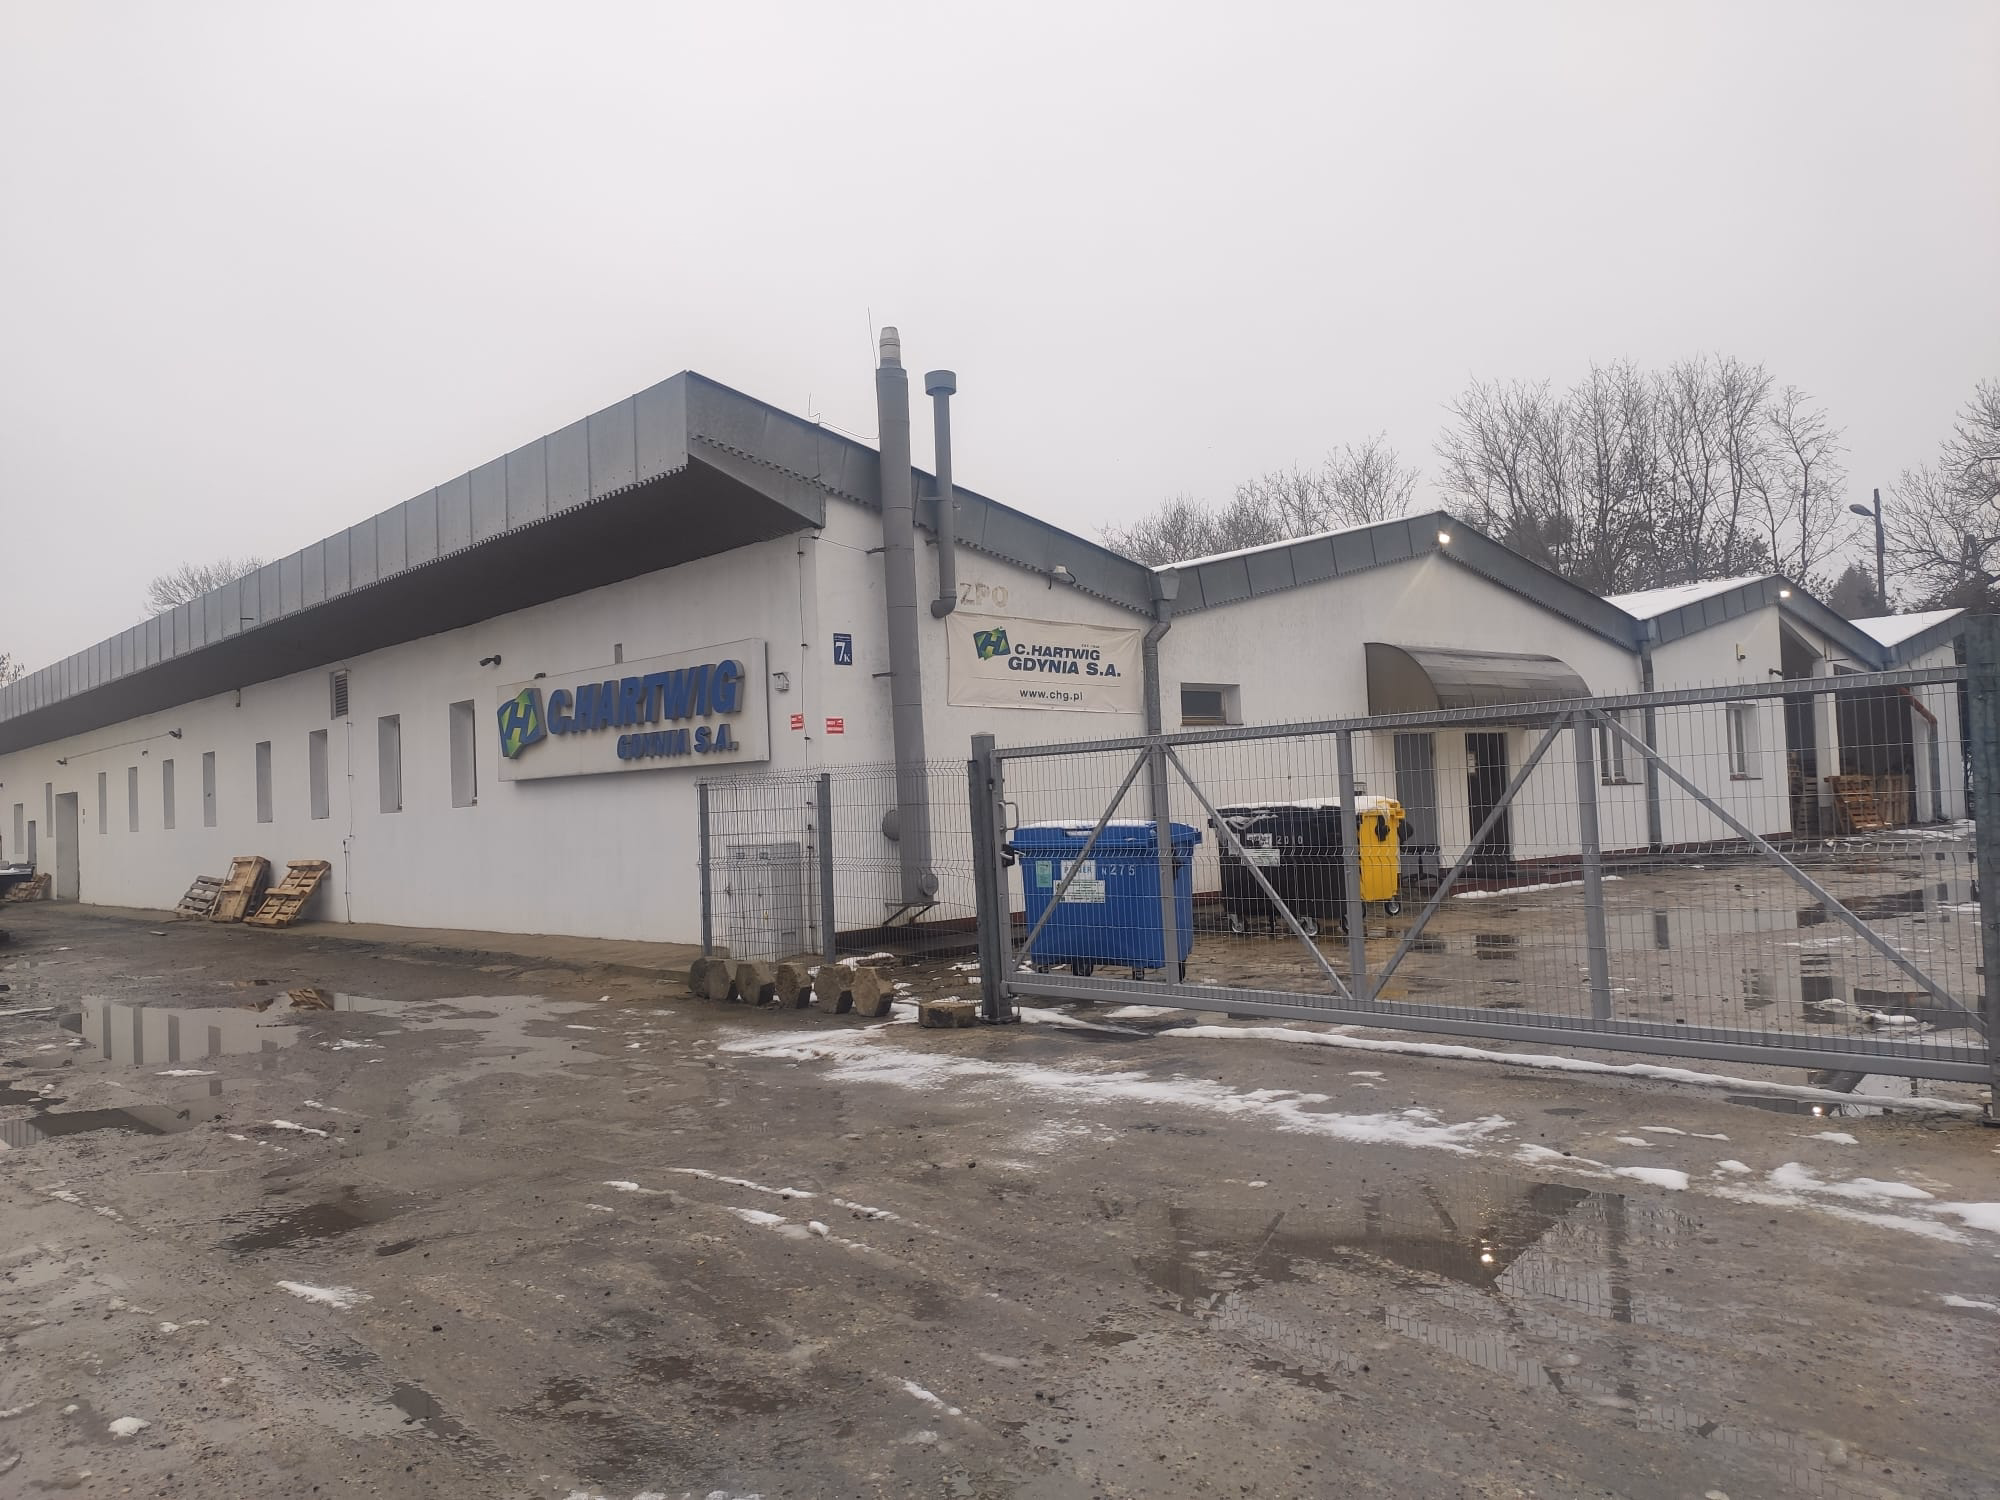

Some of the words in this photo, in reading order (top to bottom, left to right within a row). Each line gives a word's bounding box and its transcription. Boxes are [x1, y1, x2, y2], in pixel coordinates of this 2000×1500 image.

[1007, 656, 1079, 675] GDYNIA
[1086, 662, 1121, 677] S.A.
[1019, 689, 1083, 701] www.chg.pl
[694, 724, 739, 753] S.A.
